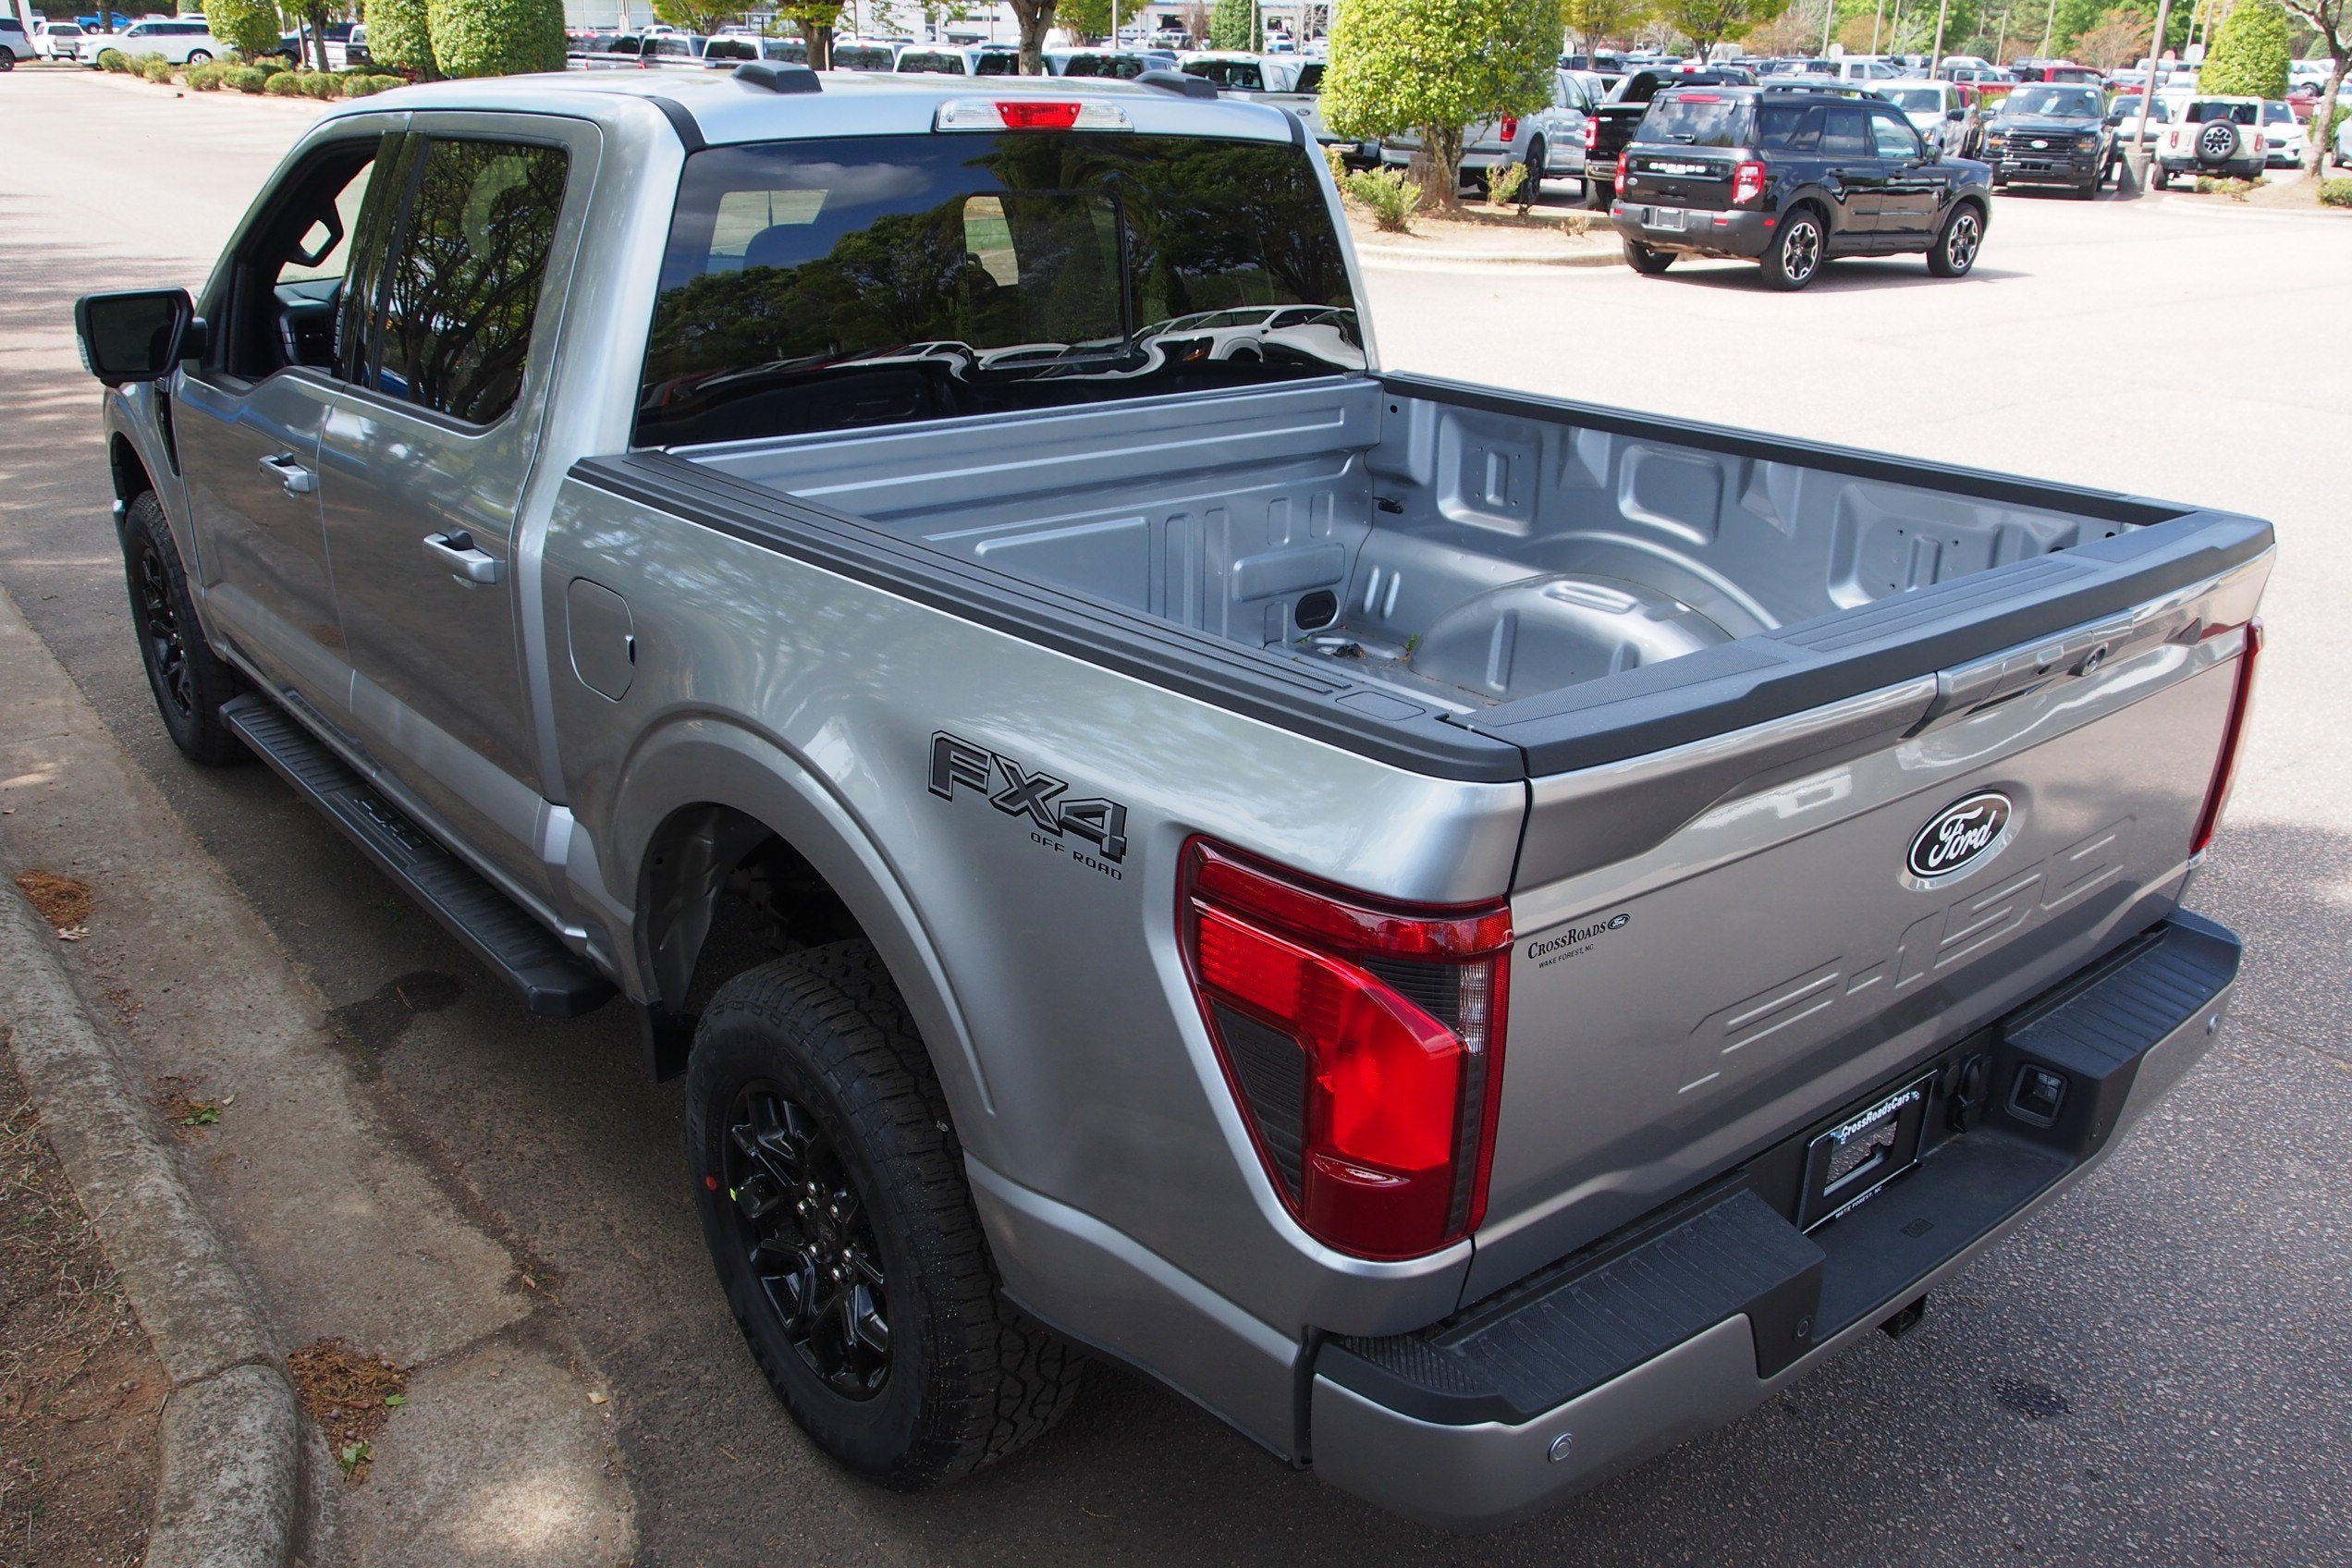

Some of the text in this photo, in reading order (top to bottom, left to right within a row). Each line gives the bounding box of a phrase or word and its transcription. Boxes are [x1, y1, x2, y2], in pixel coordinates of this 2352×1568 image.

[928, 730, 1128, 865] FX4
[1030, 832, 1122, 881] OFF ROAD
[1928, 806, 1997, 868] Ford
[1538, 957, 1557, 969] WAKE
[1558, 947, 1585, 962] FOREST,
[1677, 815, 2137, 1095] F-150
[1841, 1091, 1911, 1138] CrossRoadsCars
